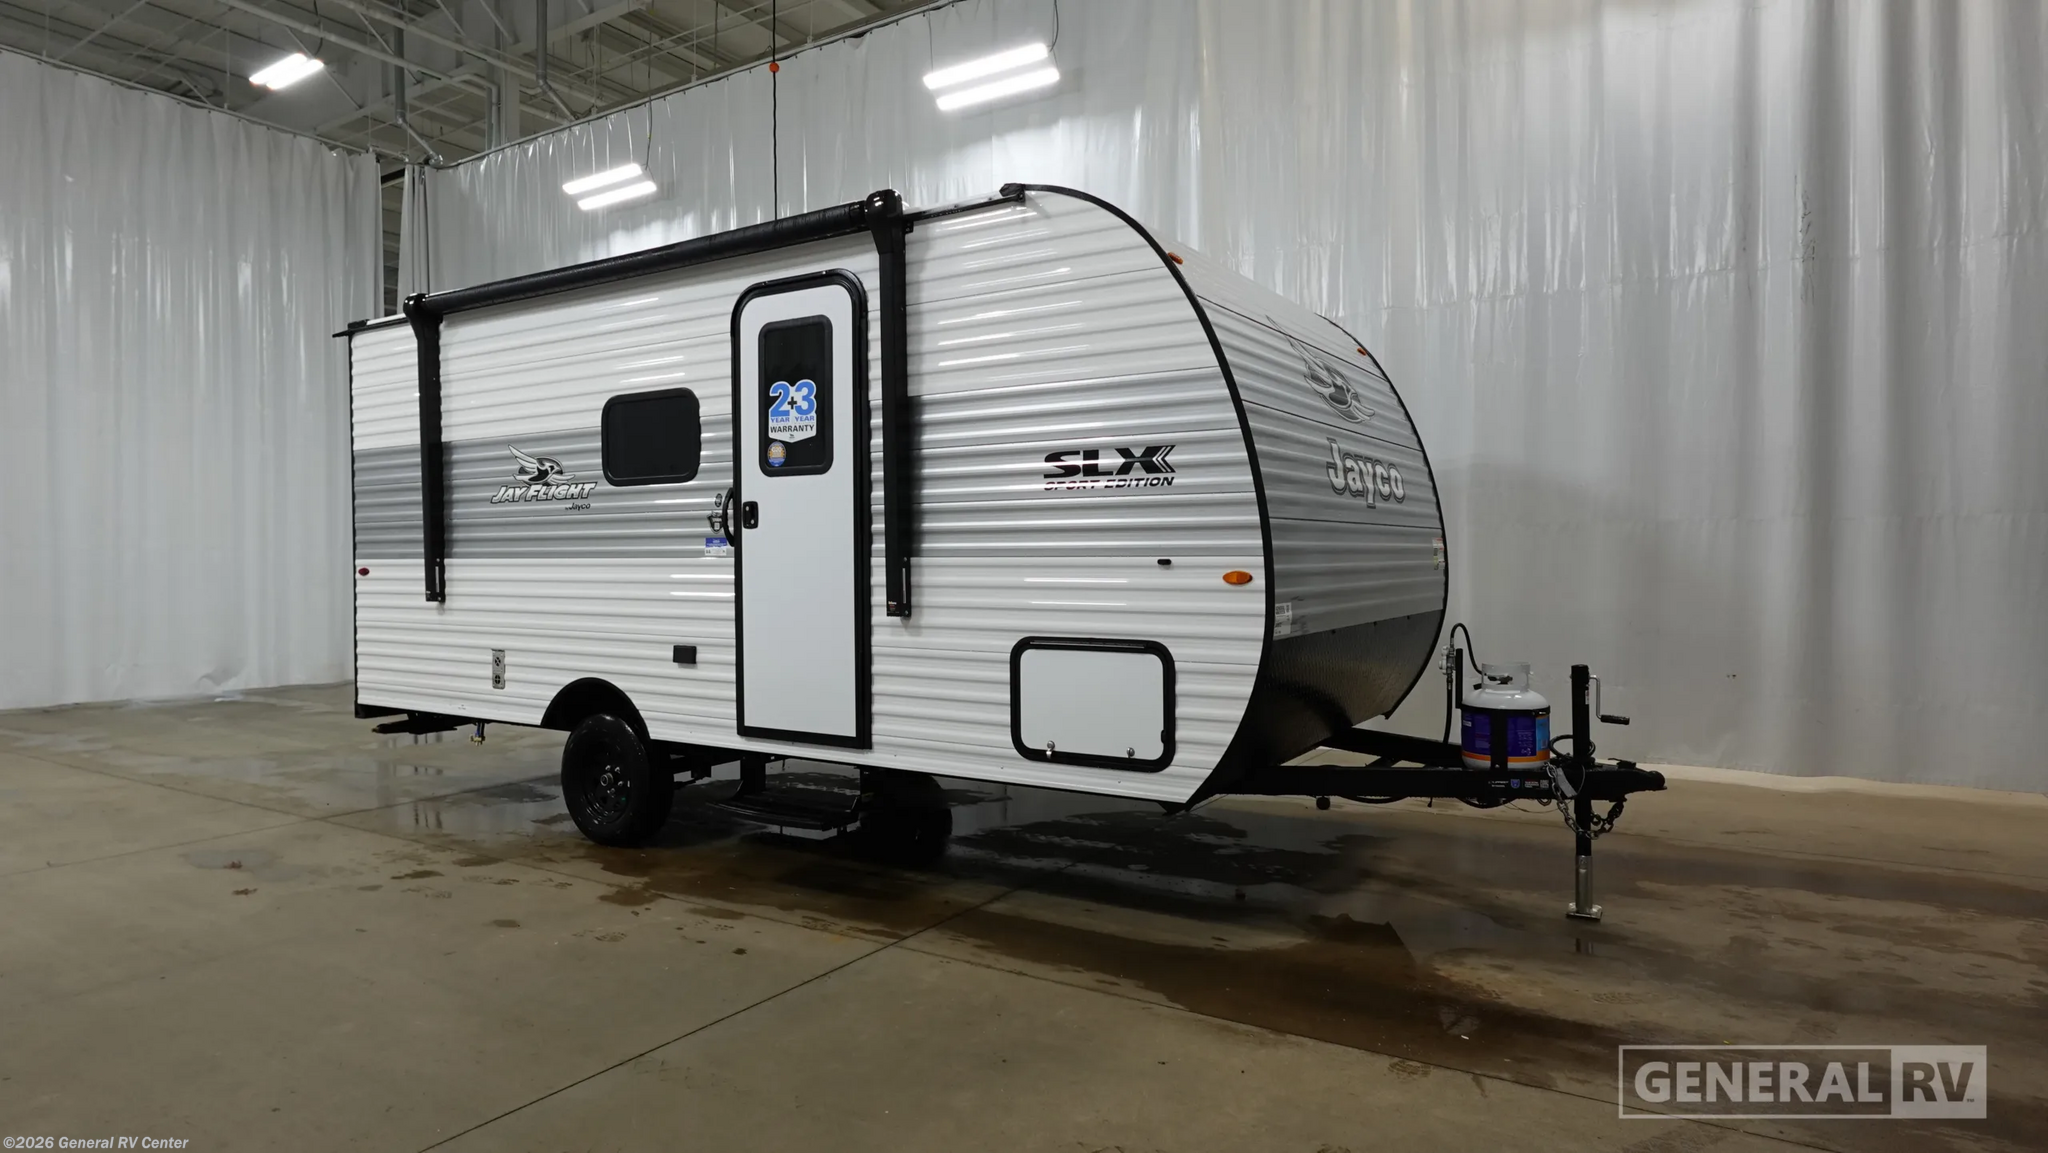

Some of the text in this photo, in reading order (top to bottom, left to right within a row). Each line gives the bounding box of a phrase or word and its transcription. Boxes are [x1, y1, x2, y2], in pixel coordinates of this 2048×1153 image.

[770, 424, 815, 434] WARRANTY
[1044, 445, 1176, 479] SLX
[1326, 437, 1406, 508] Jayco
[490, 482, 598, 503] JAY FLIGHT
[1044, 477, 1175, 491] SPORT EDITION
